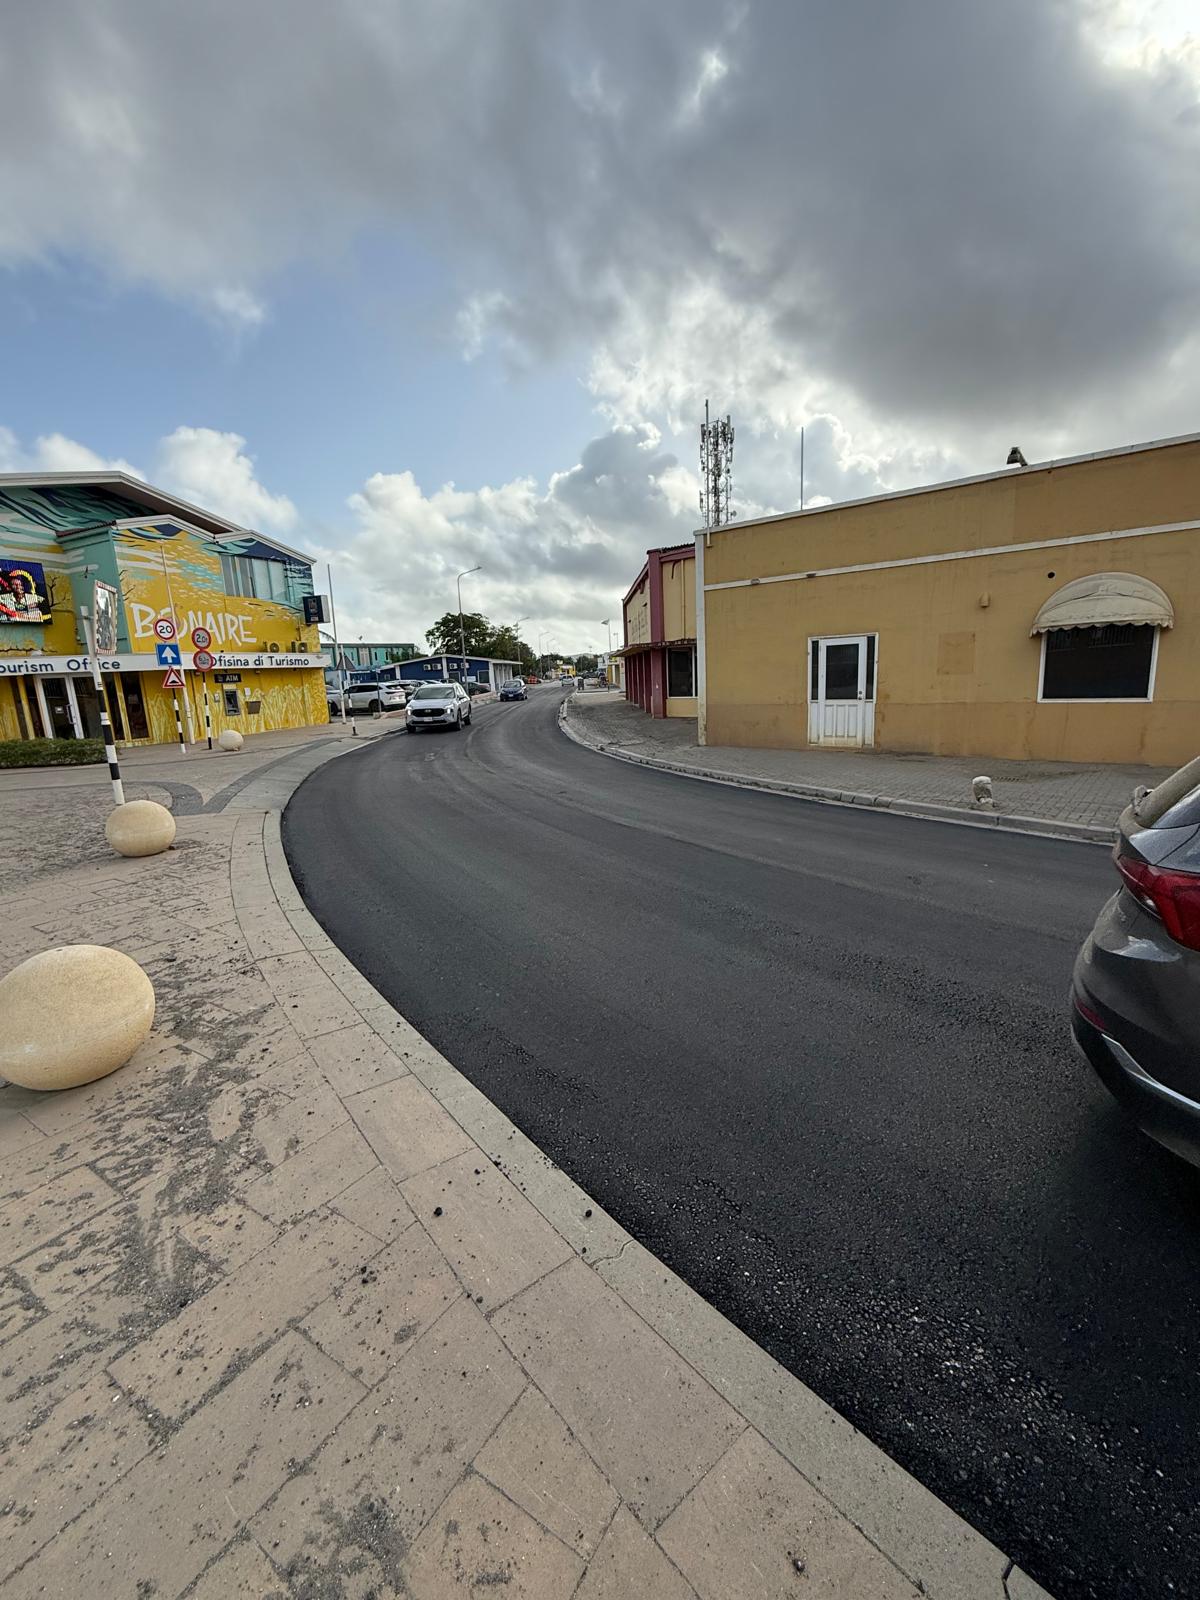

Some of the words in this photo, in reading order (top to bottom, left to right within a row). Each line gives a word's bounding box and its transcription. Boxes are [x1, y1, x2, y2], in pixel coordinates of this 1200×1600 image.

[130, 602, 257, 647] BONAIRE
[158, 625, 173, 634] 20
[66, 658, 121, 671] Ofice
[253, 655, 264, 667] di
[267, 655, 310, 667] Turismo
[225, 674, 239, 682] ATM
